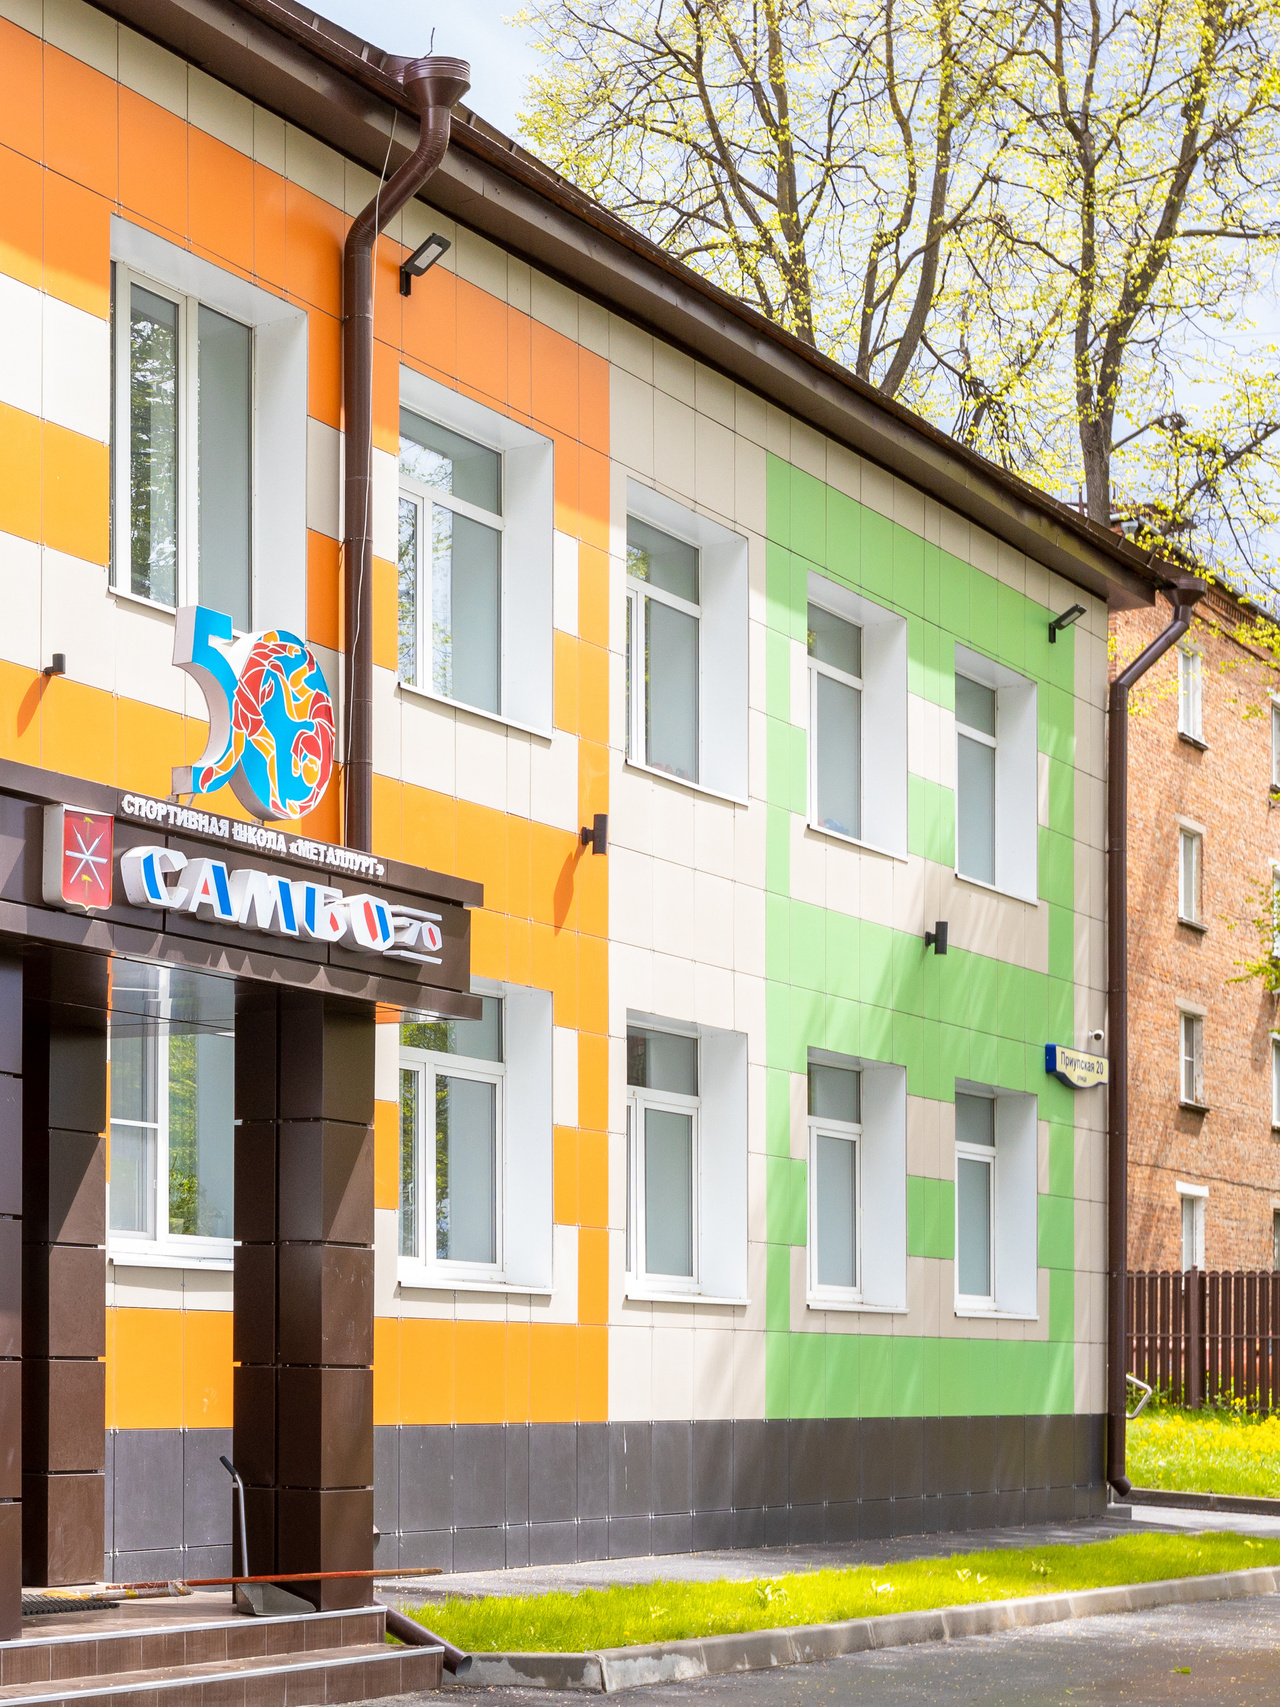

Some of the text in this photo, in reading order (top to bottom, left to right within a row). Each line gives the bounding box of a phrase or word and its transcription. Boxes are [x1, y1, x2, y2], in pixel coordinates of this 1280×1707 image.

[172, 605, 336, 821] 50
[122, 794, 385, 876] СПОРТИВНАЯ ШКОЛА «МЕТАЛЛУРГ»
[120, 845, 395, 952] САМБО
[1060, 1051, 1104, 1075] Приупская 20
